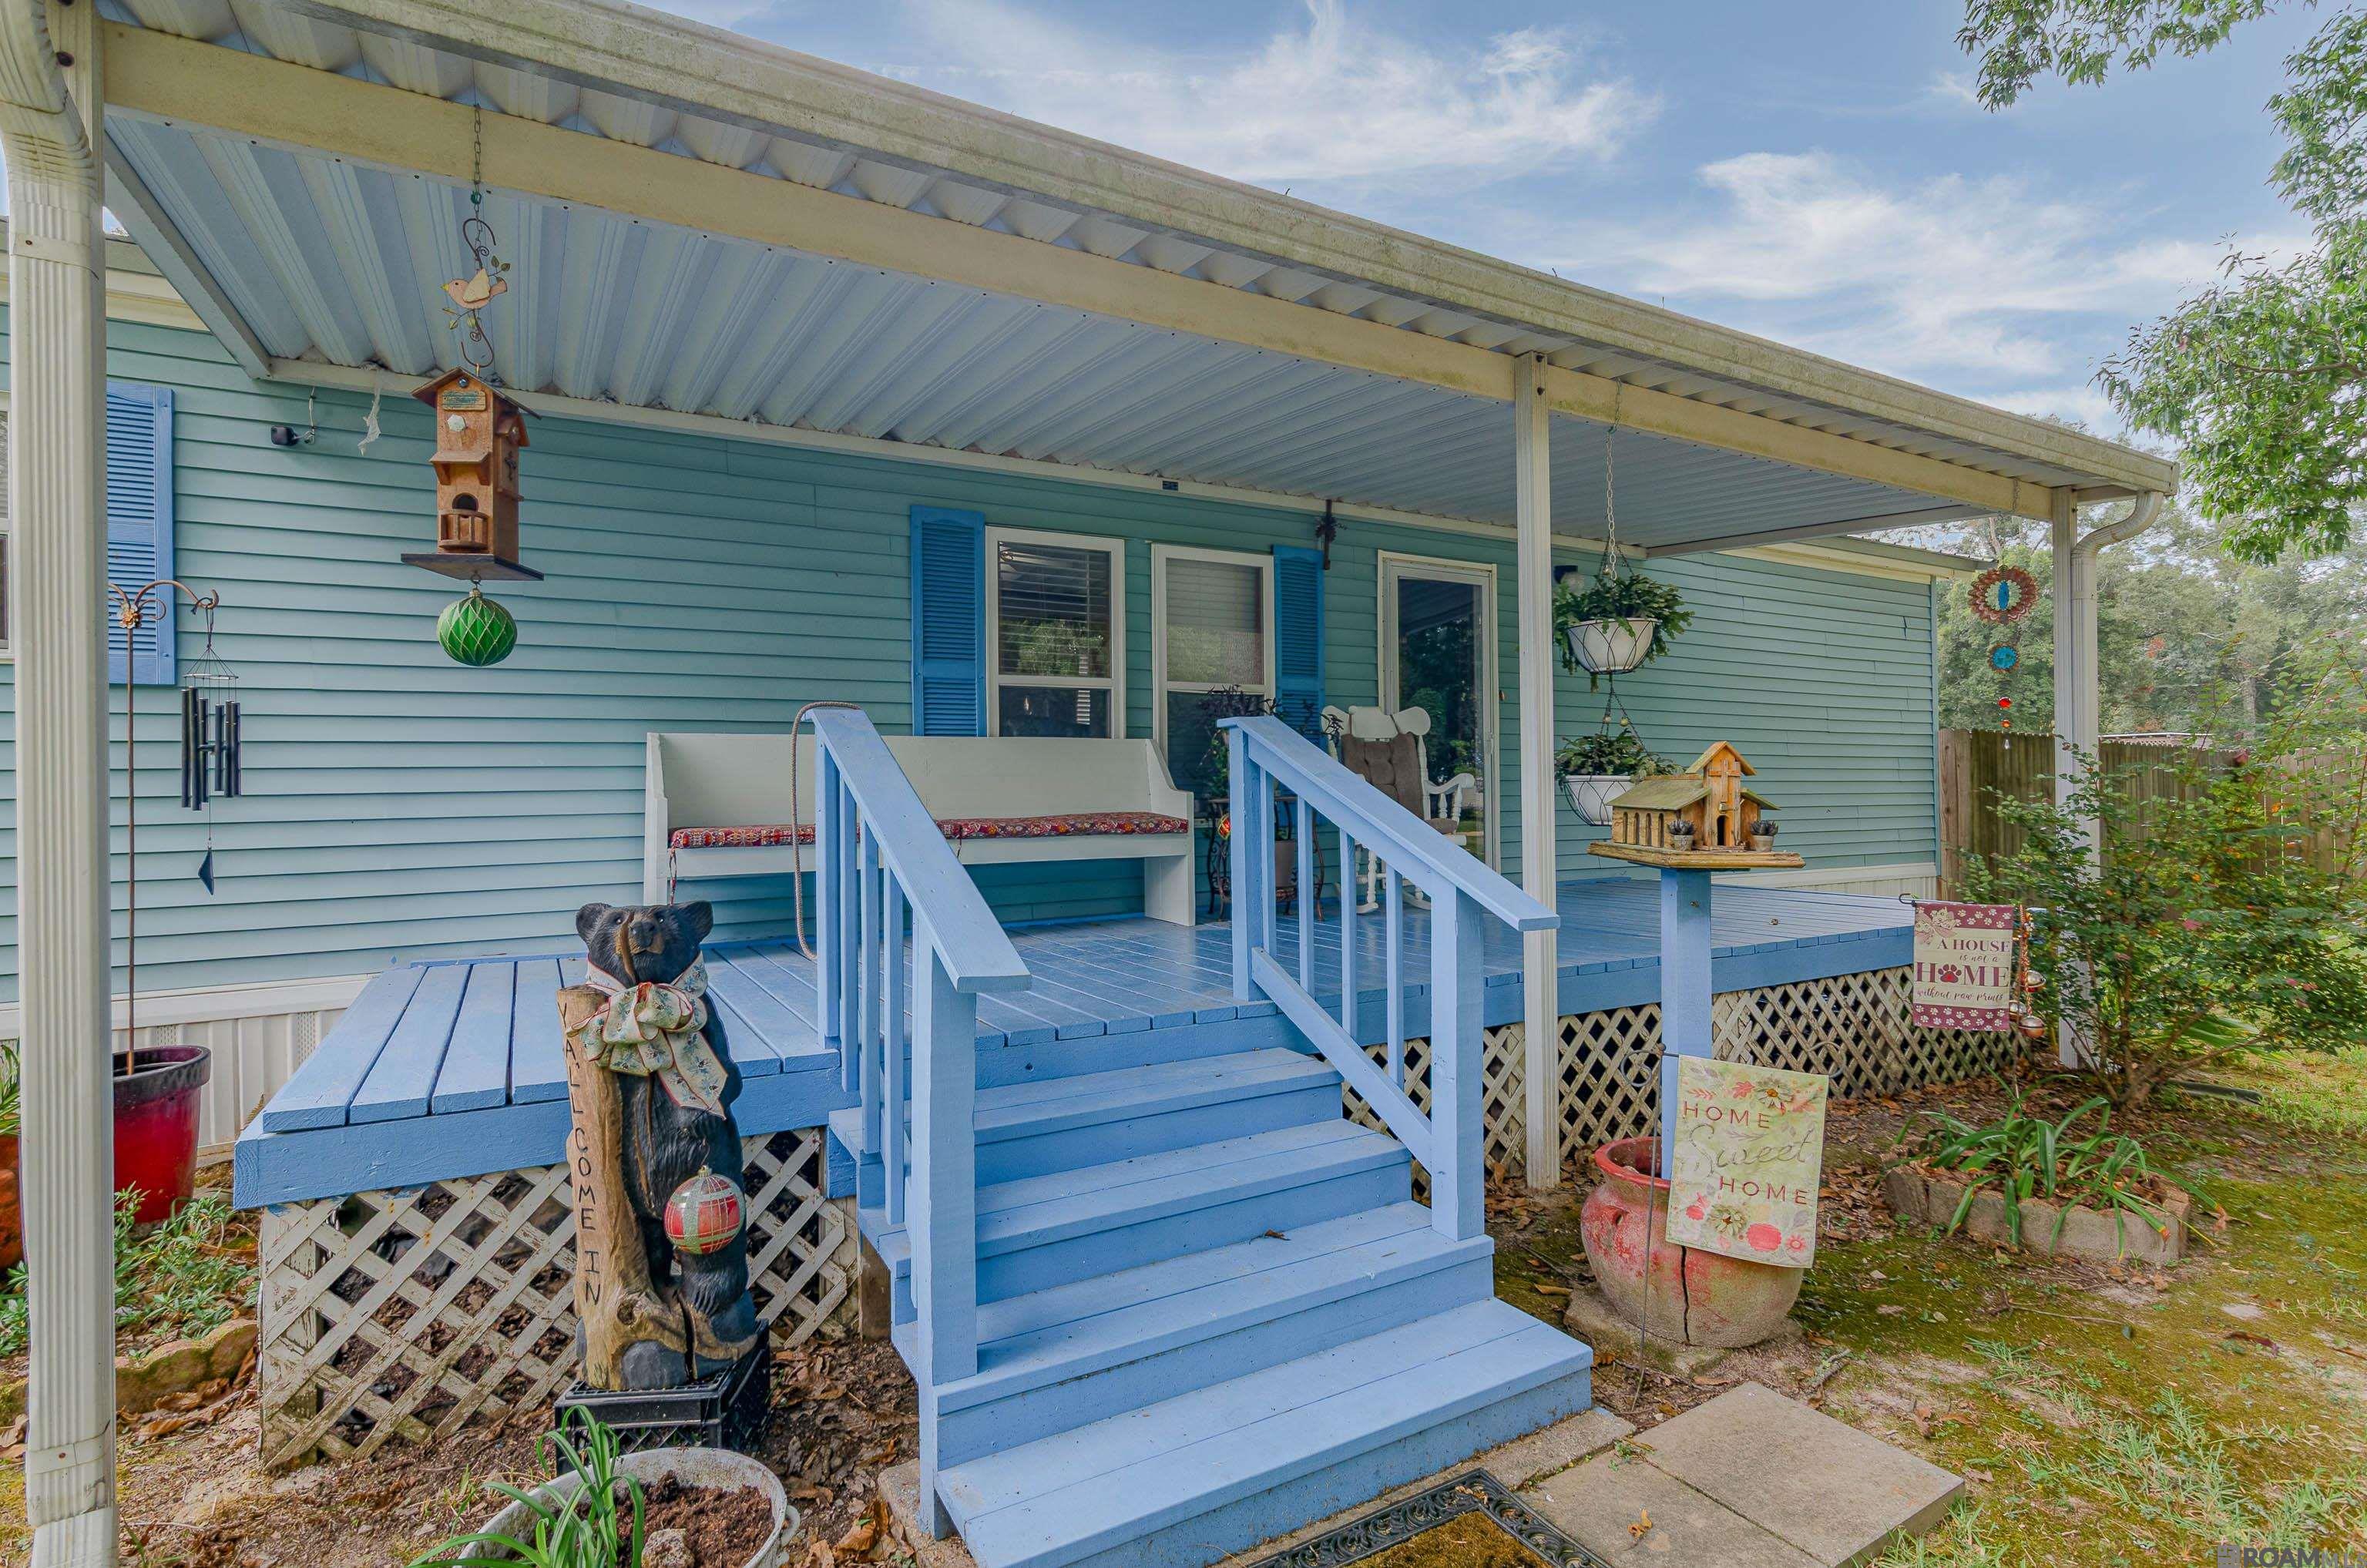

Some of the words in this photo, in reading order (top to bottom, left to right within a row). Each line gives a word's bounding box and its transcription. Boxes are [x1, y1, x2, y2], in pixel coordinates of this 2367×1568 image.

[1937, 938, 1949, 950] A
[1953, 939, 2010, 952] HOUSE
[1915, 962, 2009, 988] HME
[1917, 986, 1951, 999] without
[1954, 992, 1973, 1001] paw
[1976, 992, 2004, 1002] prints
[1683, 1100, 1772, 1130] HOME
[1688, 1122, 1815, 1178] Sweet
[574, 1126, 596, 1231] COME
[1719, 1176, 1810, 1205] HOME
[584, 1250, 602, 1306] IN
